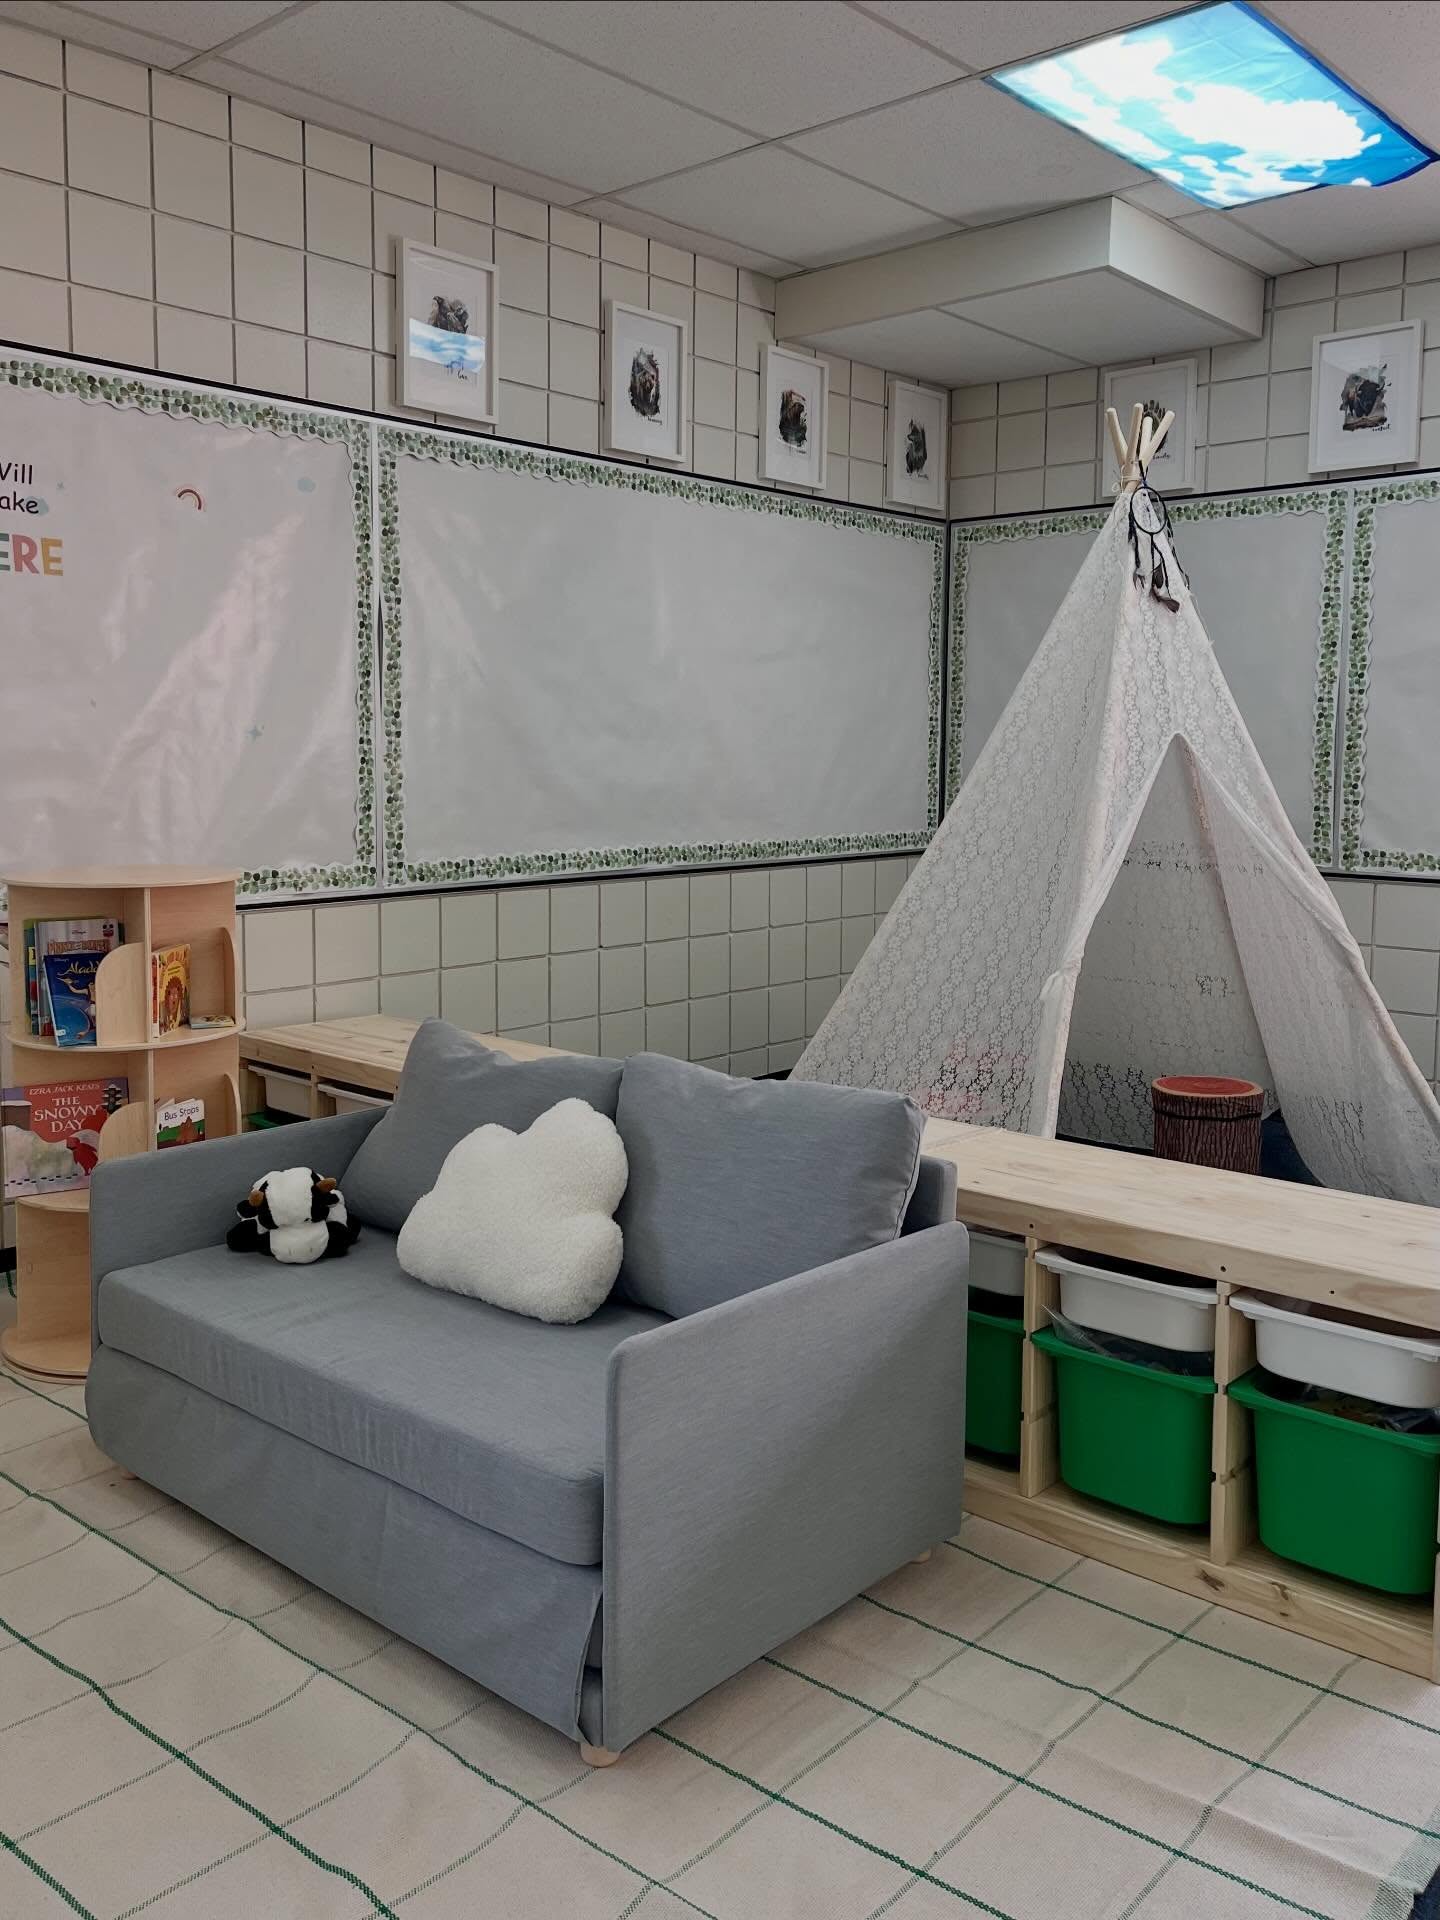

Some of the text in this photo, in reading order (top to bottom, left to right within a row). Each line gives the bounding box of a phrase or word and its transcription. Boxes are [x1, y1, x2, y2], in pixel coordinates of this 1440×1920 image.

[29, 1082, 100, 1095] EZRA JACK KEATS
[52, 1096, 80, 1106] THE
[34, 1104, 99, 1122] SNOWY
[164, 1106, 200, 1121] Bus Stops
[50, 1118, 85, 1133] DAY
